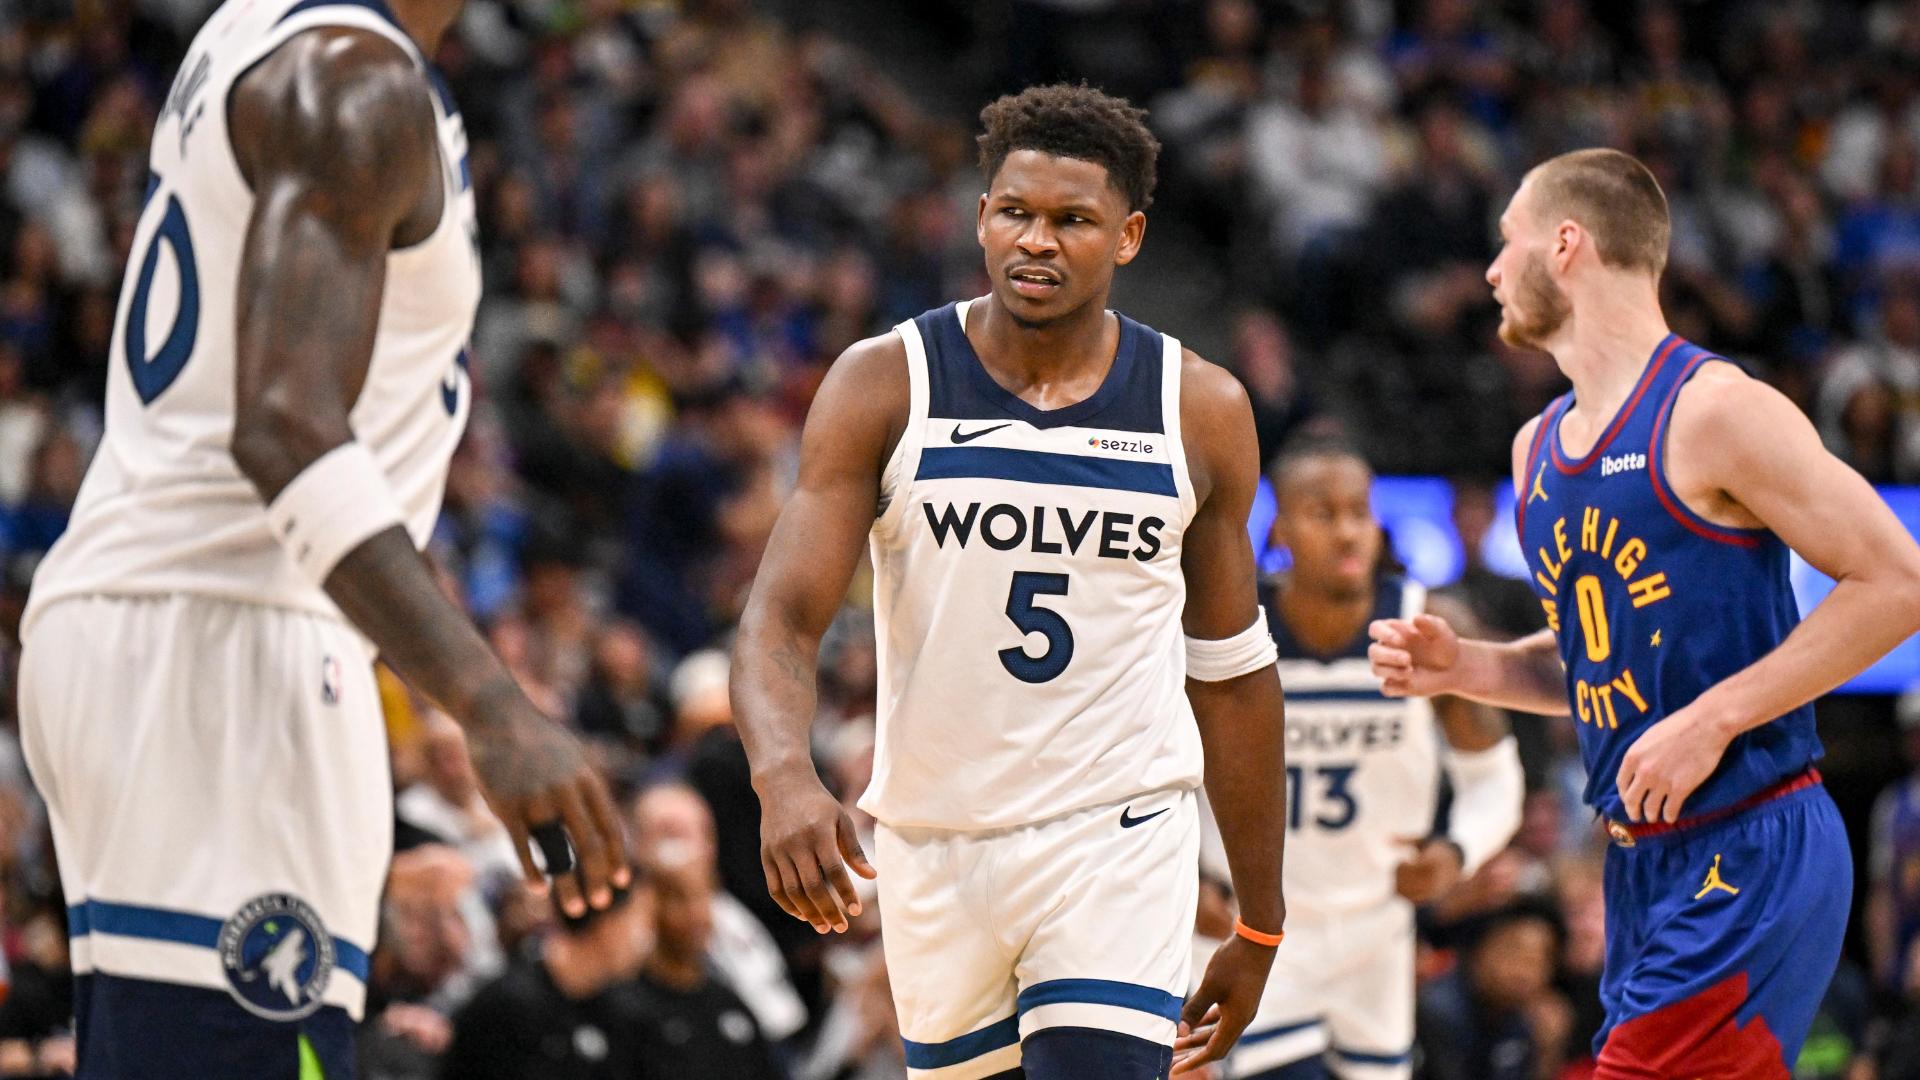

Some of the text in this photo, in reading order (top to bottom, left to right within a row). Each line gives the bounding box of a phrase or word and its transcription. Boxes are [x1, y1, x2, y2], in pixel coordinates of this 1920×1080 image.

[123, 170, 200, 405] 0
[1101, 439, 1153, 454] sezzle
[1601, 452, 1646, 477] ibotta
[922, 501, 1166, 562] WOLVES
[1581, 505, 1671, 609] HIGH
[998, 570, 1074, 684] 5
[1575, 575, 1611, 663] 0
[1576, 668, 1649, 729] CITY
[1284, 718, 1403, 750] OLVES
[1285, 765, 1358, 831] 13
